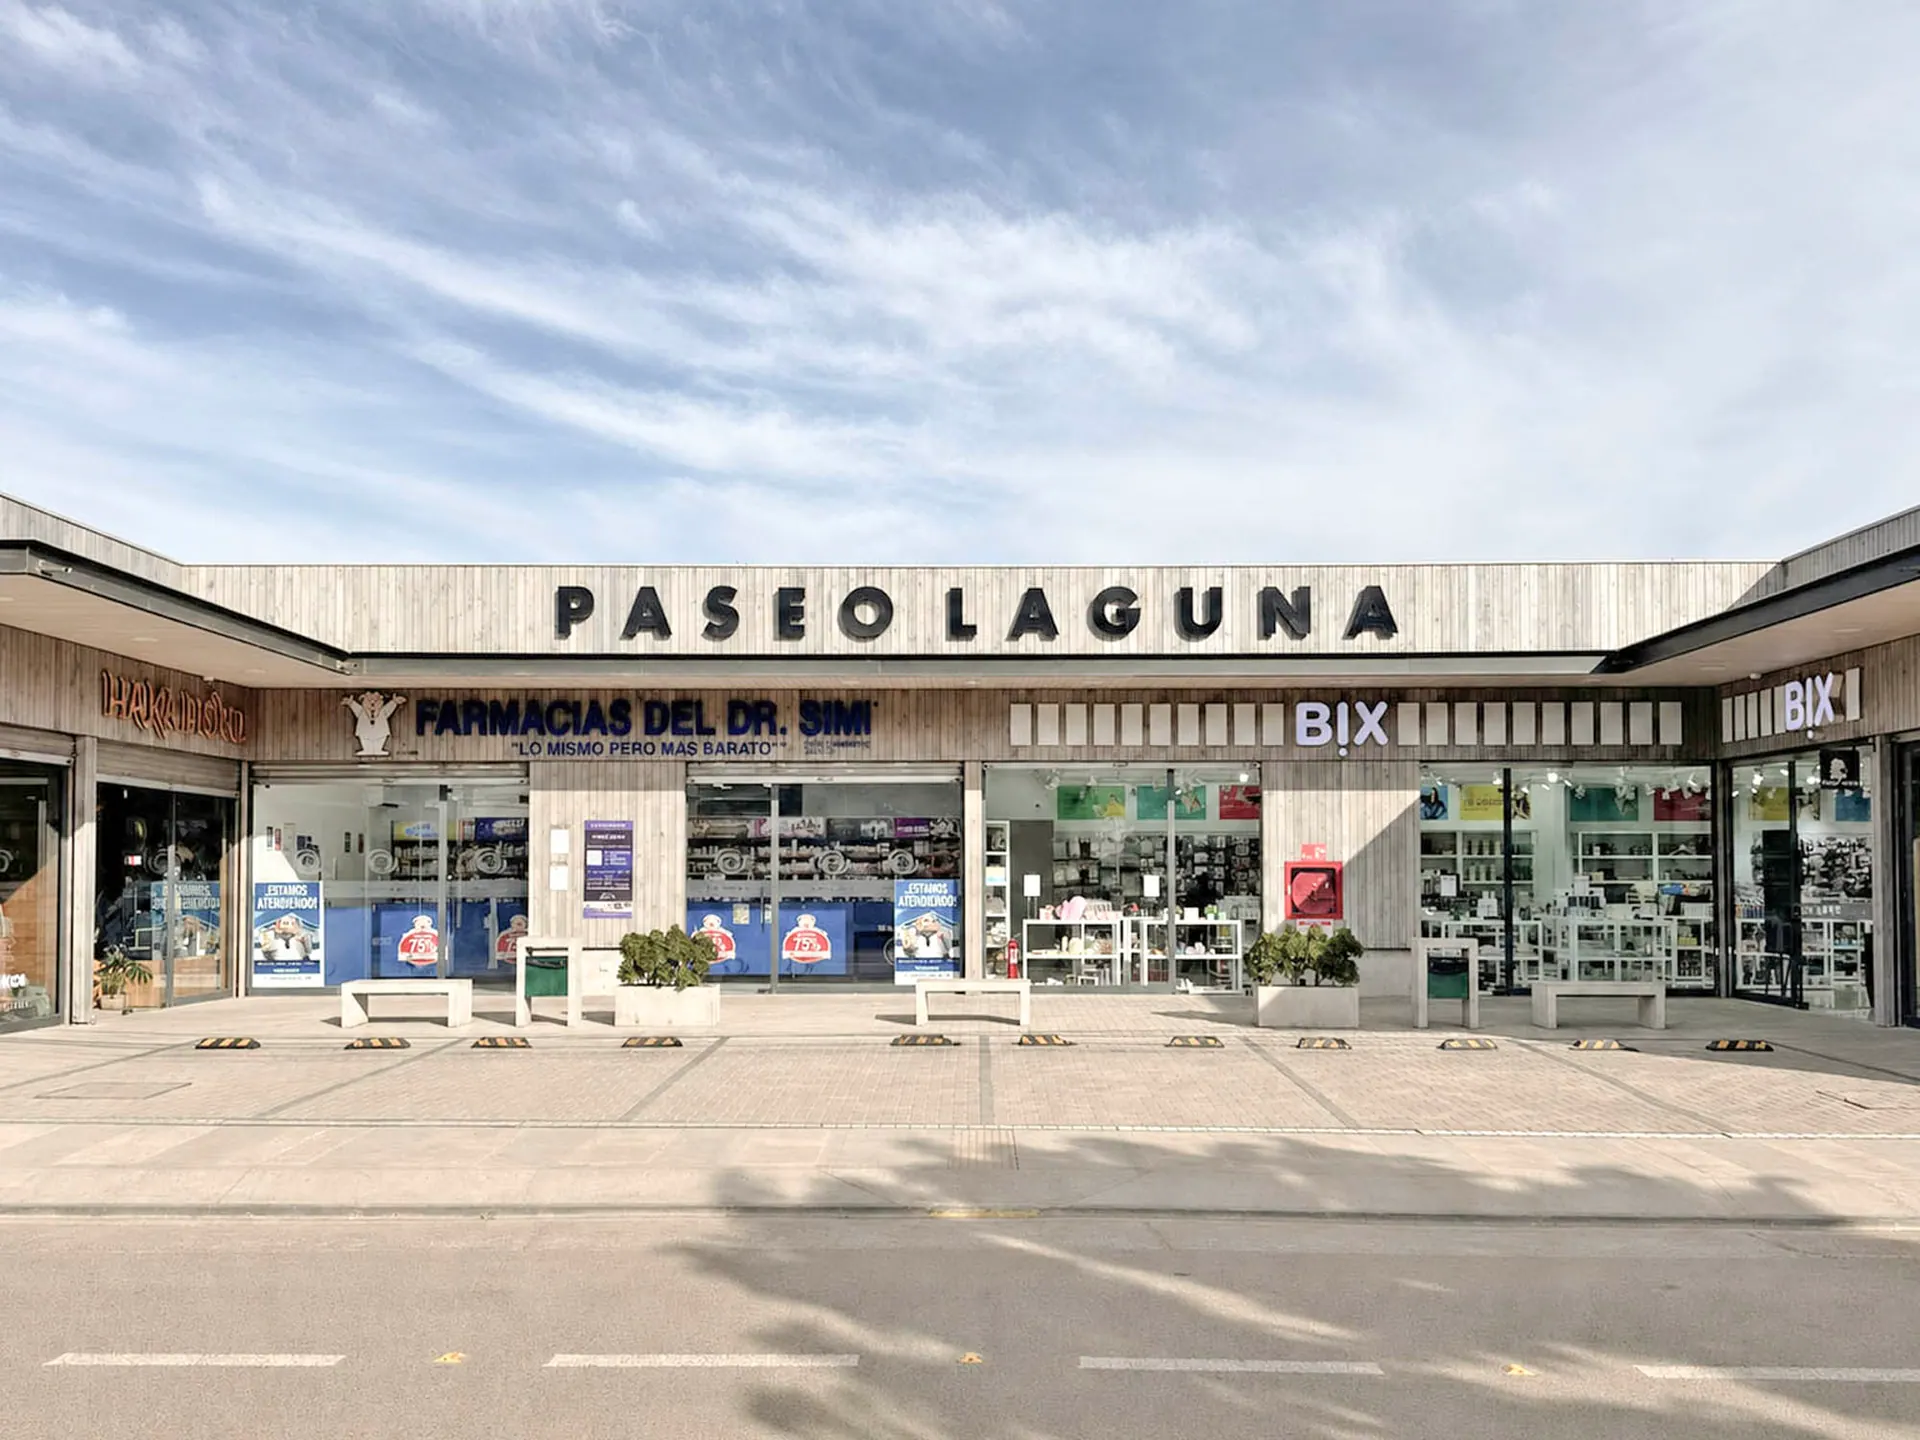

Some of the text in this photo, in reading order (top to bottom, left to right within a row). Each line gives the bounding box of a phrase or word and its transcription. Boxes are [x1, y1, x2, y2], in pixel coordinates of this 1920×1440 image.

[556, 585, 1398, 640] PASEO LAGUNA
[416, 698, 871, 737] FARMACIAS DEL DR. SIMI
[547, 741, 604, 756] MISMO
[609, 741, 656, 756] PERO
